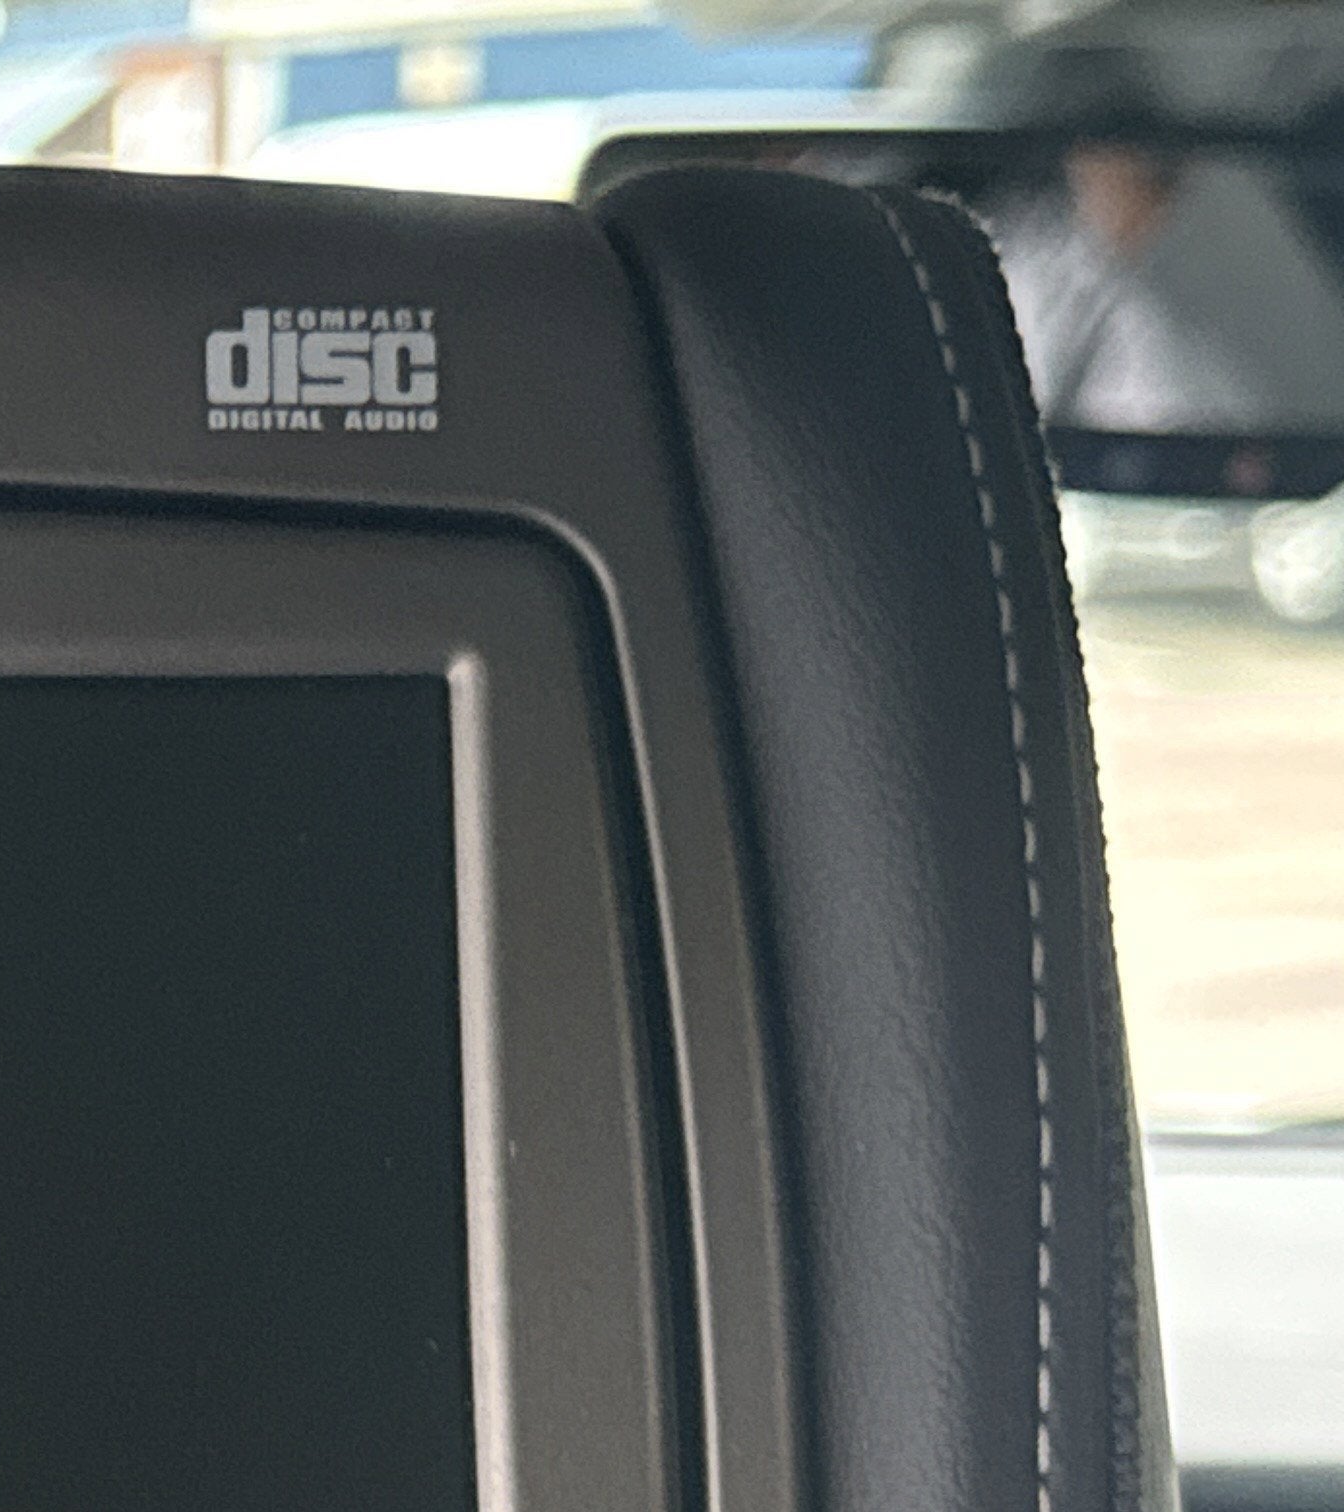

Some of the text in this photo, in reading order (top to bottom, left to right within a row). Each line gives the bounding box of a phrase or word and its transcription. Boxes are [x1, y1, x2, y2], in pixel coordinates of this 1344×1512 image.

[273, 308, 435, 330] COMPACT
[208, 410, 439, 432] DIGITAL AUDIO
